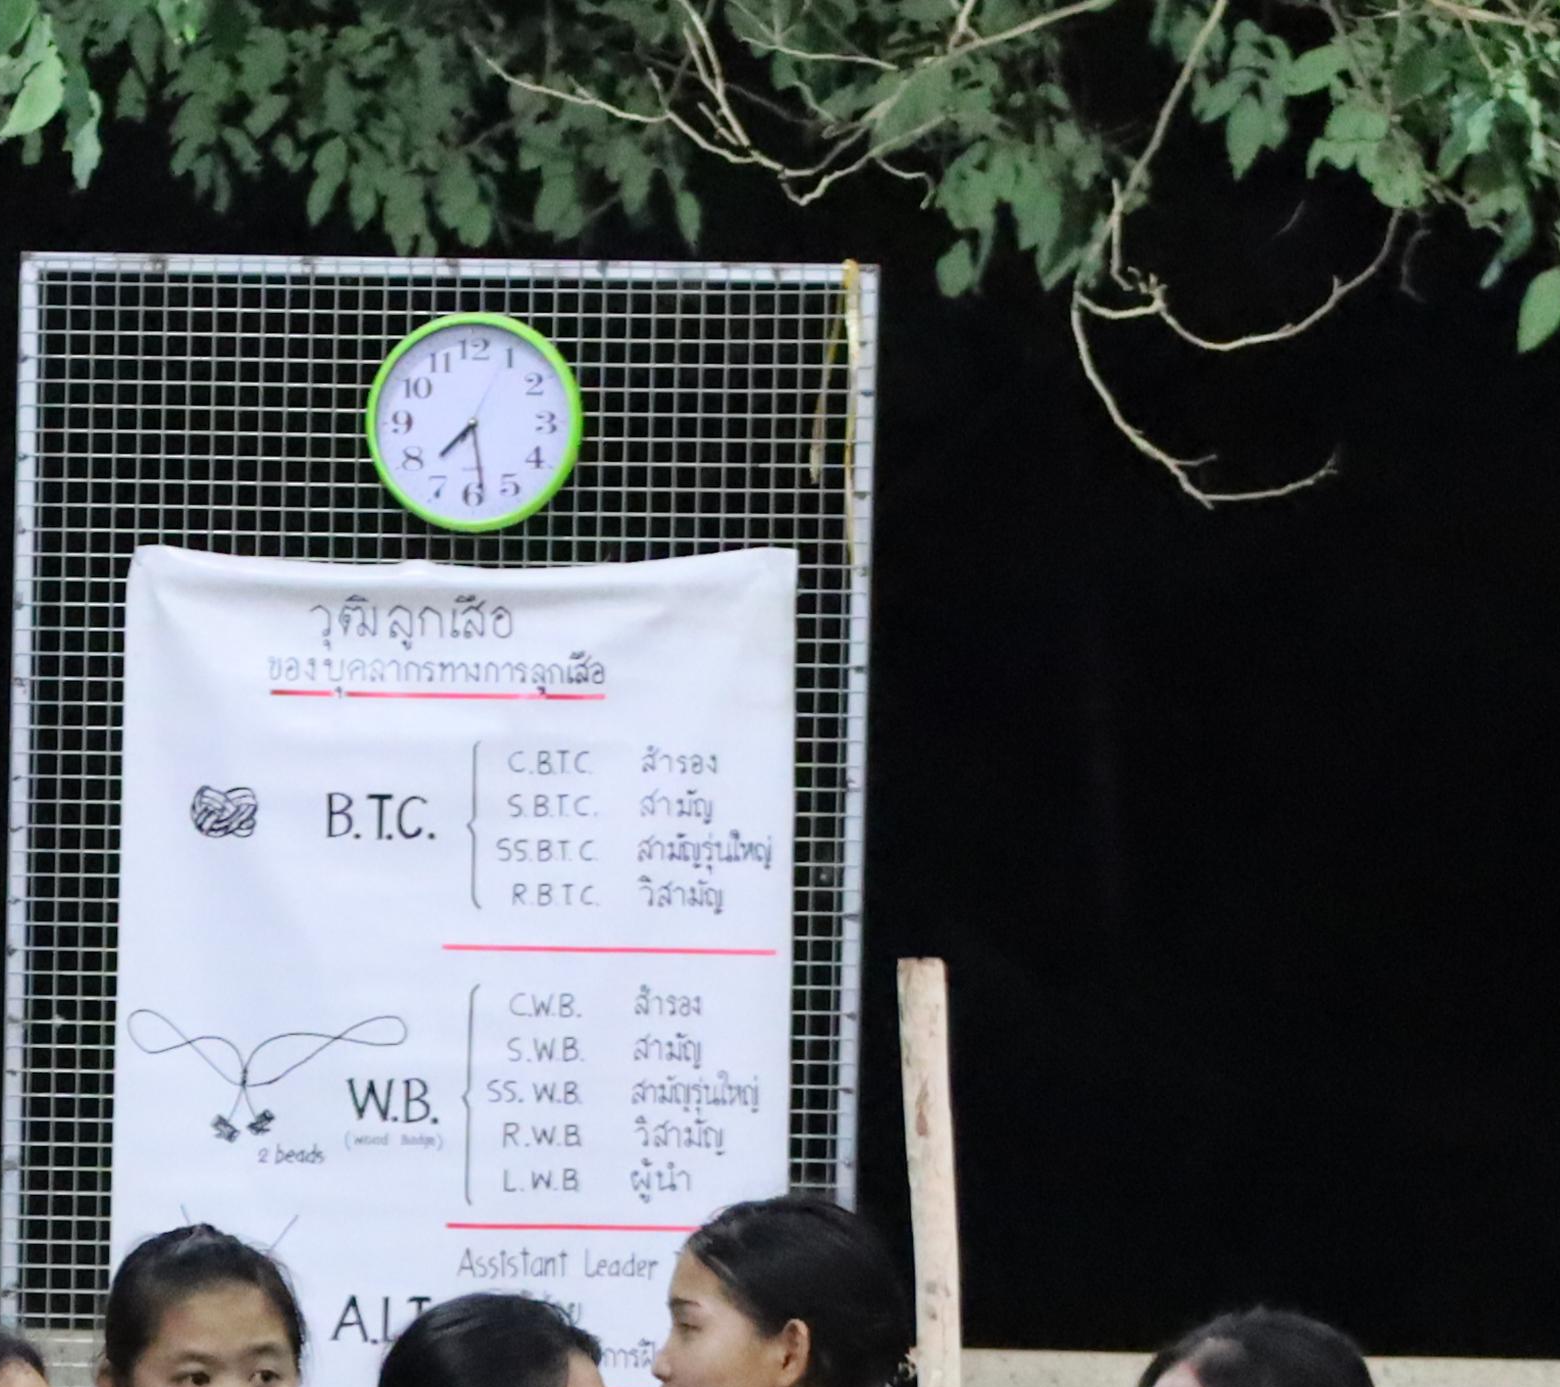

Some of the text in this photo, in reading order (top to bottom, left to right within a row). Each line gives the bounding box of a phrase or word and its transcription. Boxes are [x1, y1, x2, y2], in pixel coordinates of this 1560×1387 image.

[430, 352, 452, 373] 11
[458, 338, 490, 361] 12
[505, 347, 514, 369] 1
[402, 377, 432, 399] 10
[524, 372, 544, 396] 2
[392, 411, 414, 434] 9
[535, 411, 558, 434] 3
[401, 447, 424, 471] 8
[525, 445, 546, 469] 4
[428, 475, 447, 498] 7
[462, 482, 485, 507] 6
[499, 473, 521, 497] 5
[641, 745, 719, 775] สำรอง
[326, 792, 436, 840] B.T.C.
[640, 788, 714, 825] สามัญ
[637, 829, 773, 875] สามัญรุ่นใหญ่
[638, 875, 724, 915] วิสามัญ
[508, 992, 582, 1018] C.W.B.
[634, 984, 703, 1016] สำรอง
[506, 1036, 586, 1062] S.W.B.
[633, 1032, 703, 1069] สามัญ
[346, 1077, 440, 1126] W.B.
[631, 1070, 760, 1116] สามัญรุ่นใหญ่
[634, 1115, 726, 1156] วิสามัญ
[257, 1143, 326, 1165] 2 beads
[630, 1158, 692, 1203] ผู้นำ
[457, 1247, 569, 1280] Assistant
[583, 1250, 660, 1280] Leader
